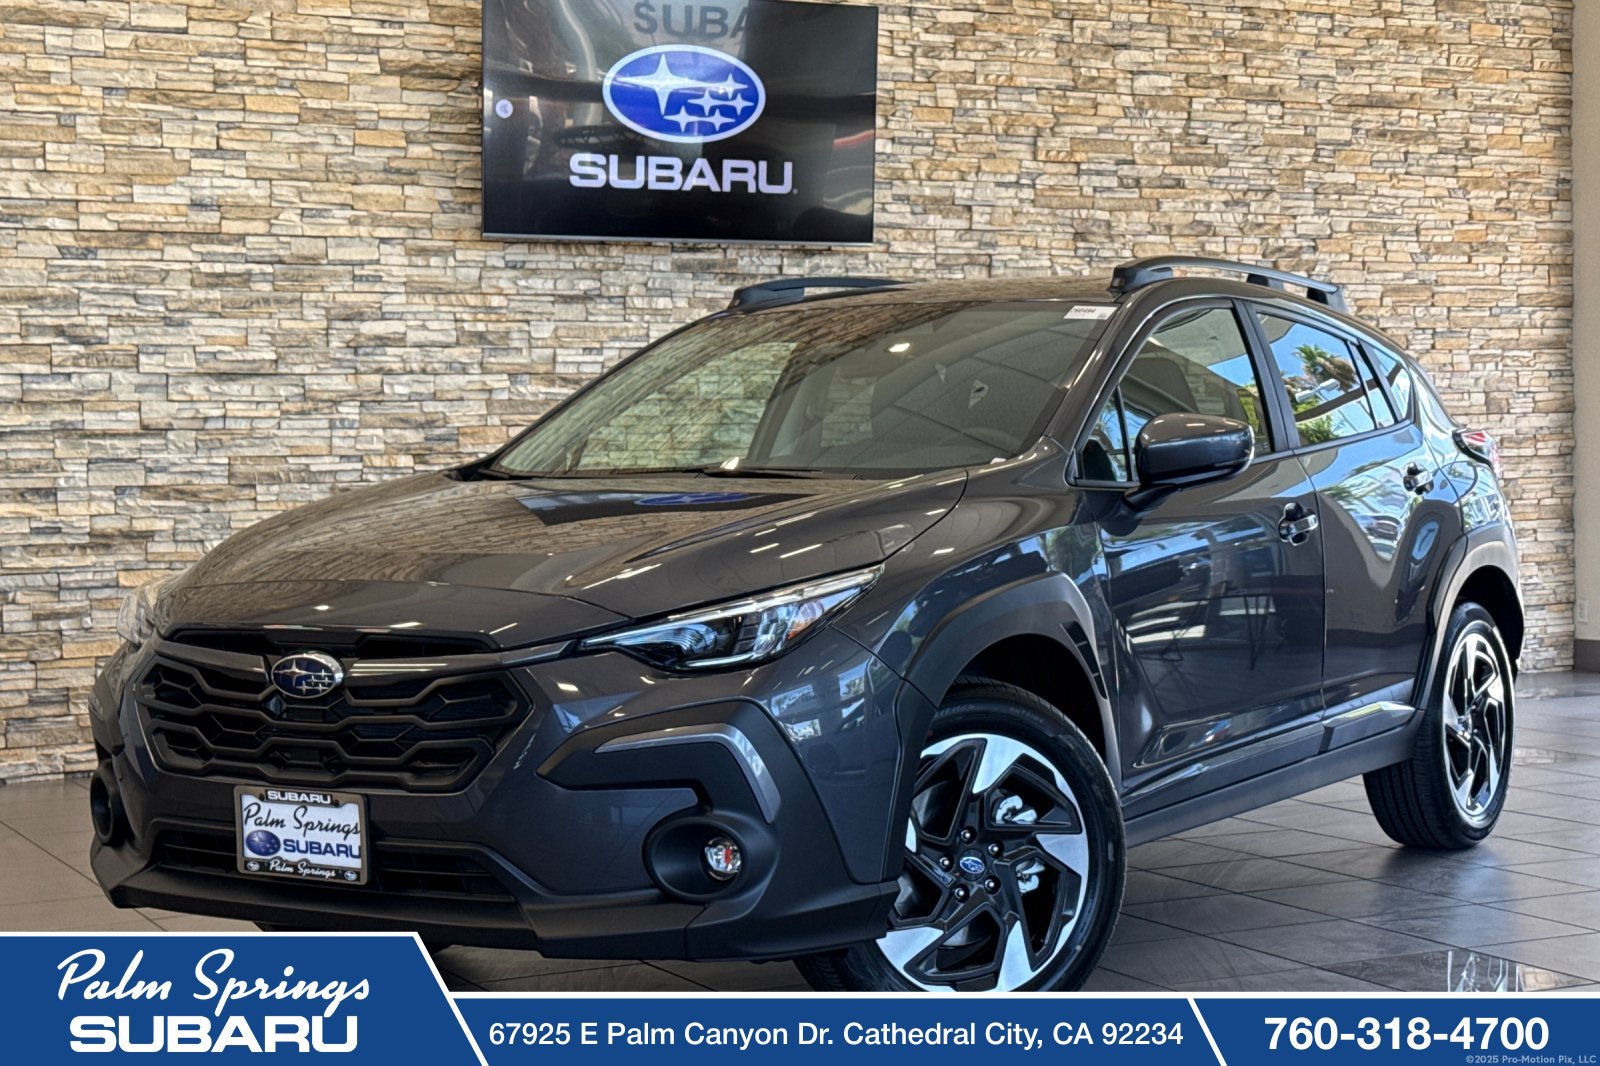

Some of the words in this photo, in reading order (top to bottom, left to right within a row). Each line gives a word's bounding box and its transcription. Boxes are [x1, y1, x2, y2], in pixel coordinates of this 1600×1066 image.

[569, 152, 794, 194] SUBARU
[267, 791, 331, 804] SUBARU
[244, 802, 286, 828] Palm
[293, 805, 361, 841] Springs
[283, 838, 362, 859] SUBARU
[269, 858, 294, 873] Palm
[298, 862, 336, 877] Springs
